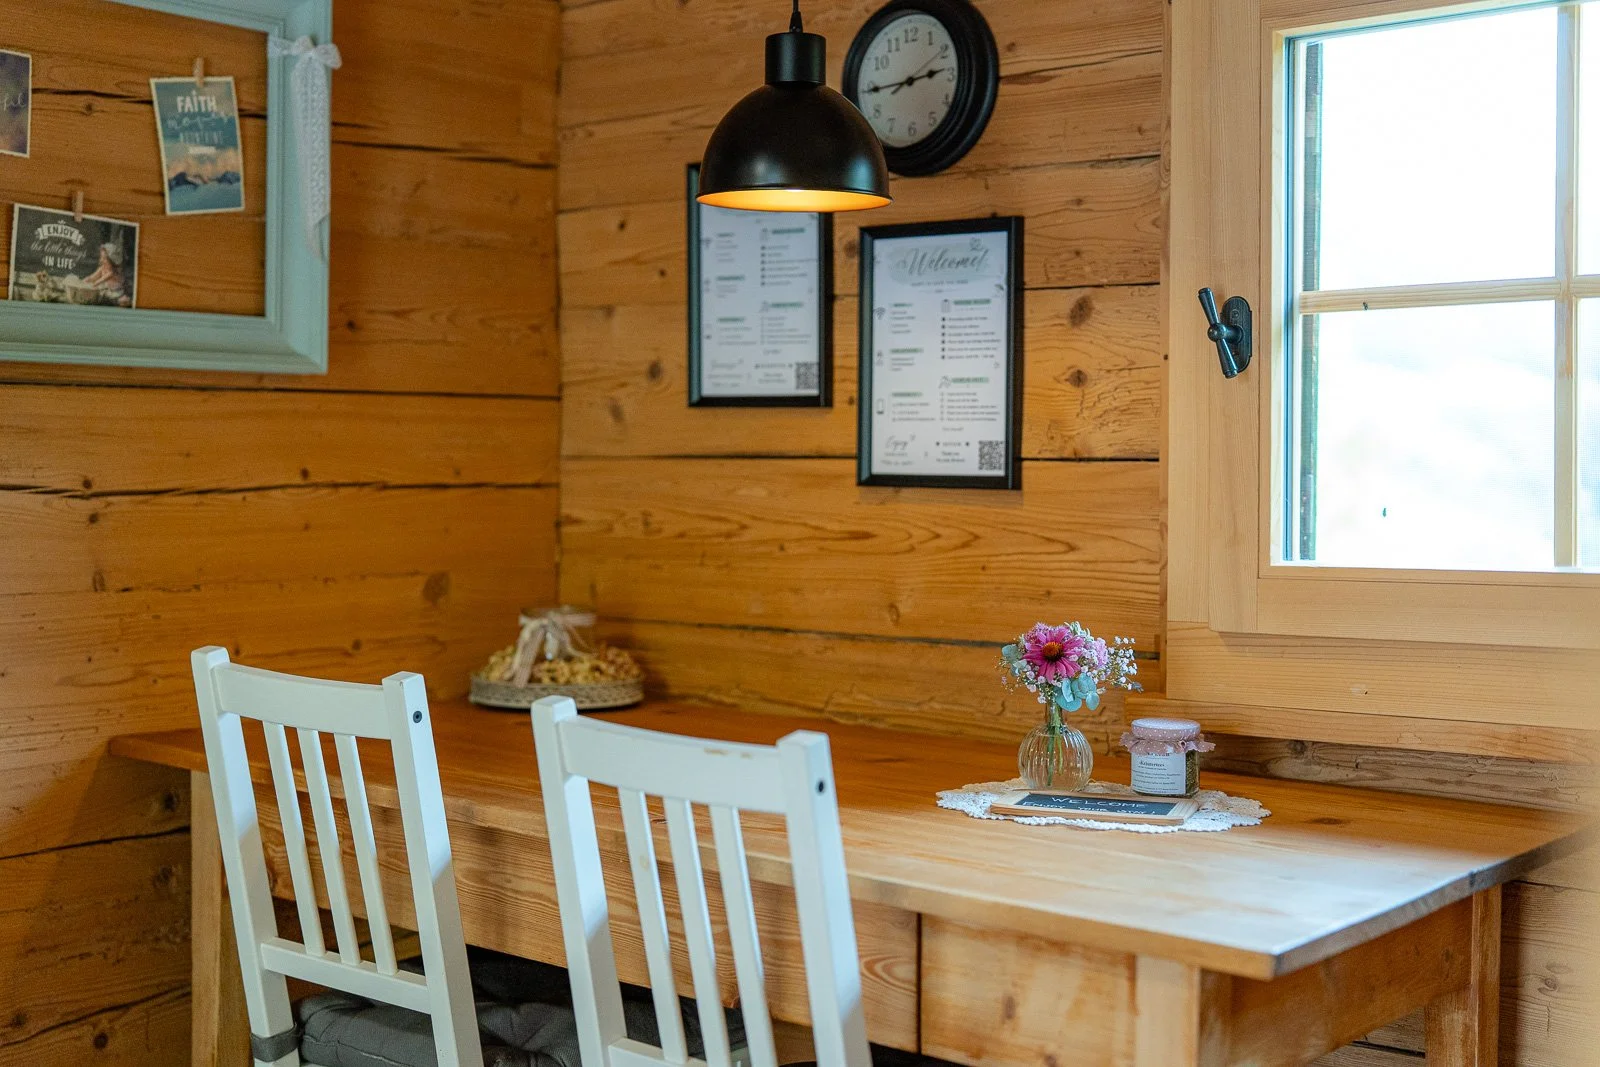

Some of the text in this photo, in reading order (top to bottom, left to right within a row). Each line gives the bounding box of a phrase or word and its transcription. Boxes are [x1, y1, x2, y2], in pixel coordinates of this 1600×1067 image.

[904, 26, 919, 43] 12
[927, 31, 934, 46] 1
[887, 37, 900, 53] 11
[940, 43, 949, 59] 2
[874, 54, 890, 71] 10
[947, 67, 955, 82] 3
[177, 91, 217, 113] FAITH
[873, 103, 881, 120] 8
[928, 111, 937, 127] 5
[886, 118, 895, 133] 7
[908, 121, 917, 137] 6
[47, 225, 75, 238] ENJOY
[30, 240, 44, 251] the
[44, 255, 73, 270] IN LIFE
[1051, 796, 1148, 809] WELCOME
